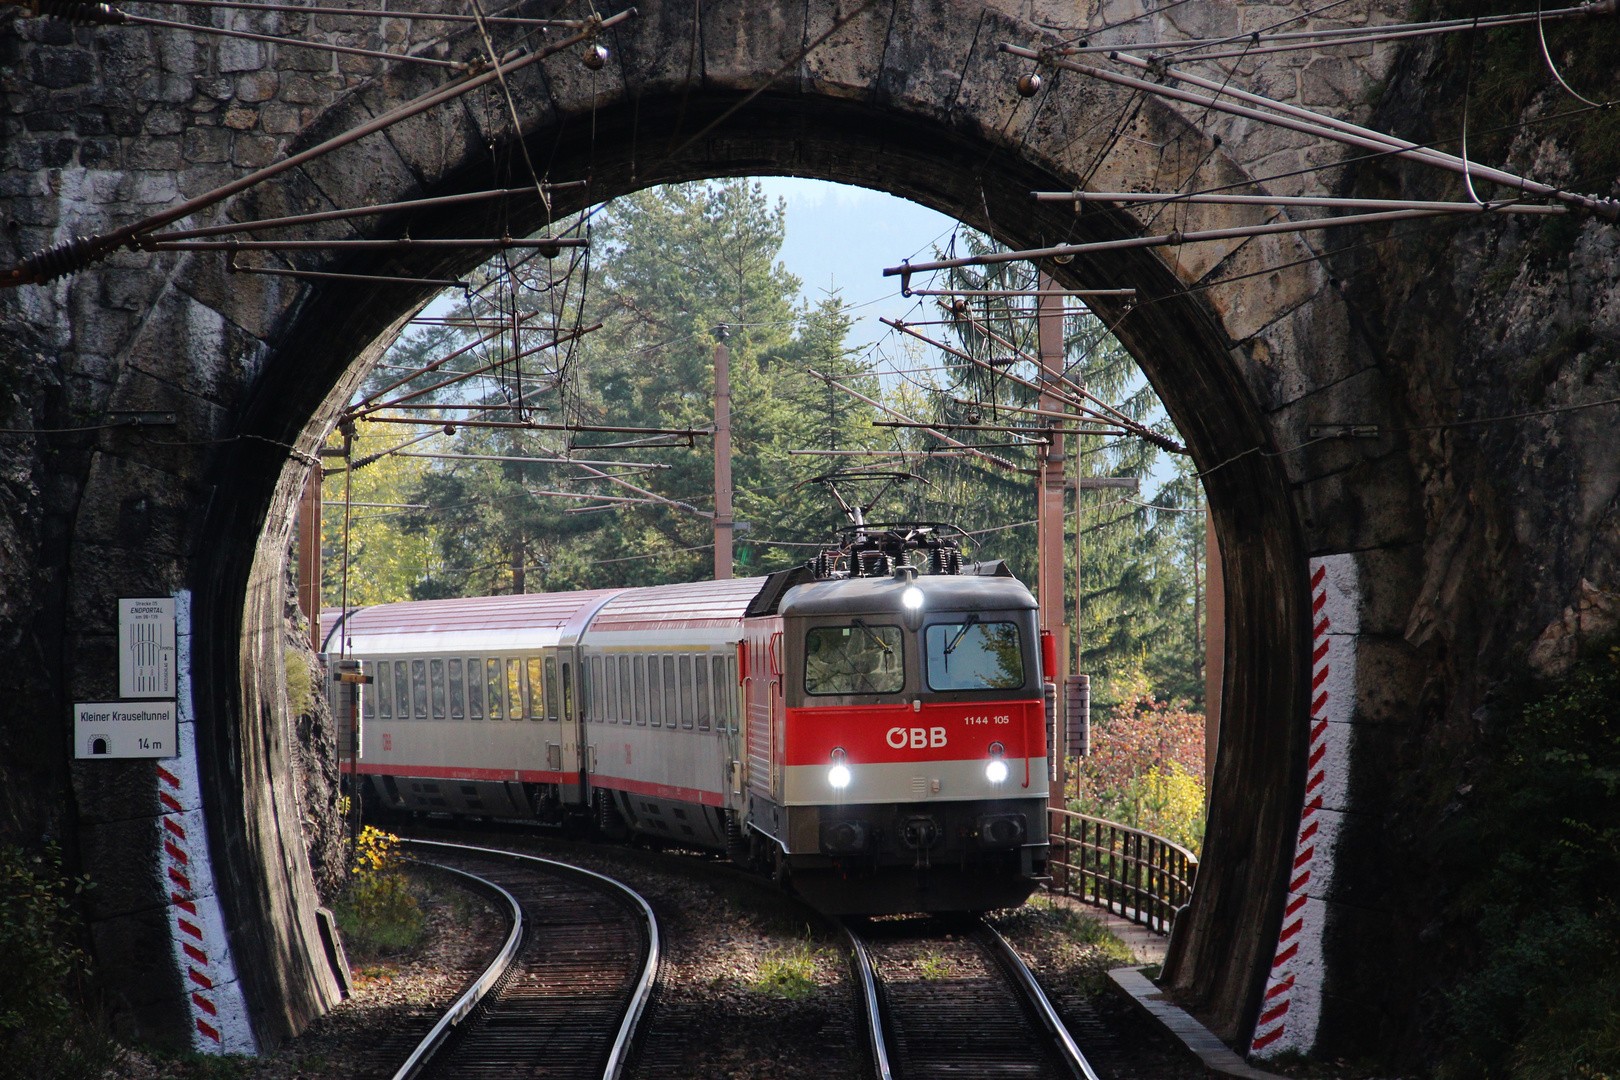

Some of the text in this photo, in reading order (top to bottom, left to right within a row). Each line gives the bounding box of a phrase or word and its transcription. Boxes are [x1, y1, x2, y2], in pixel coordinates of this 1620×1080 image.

[81, 711, 170, 722] Kleiner Krauseltunnel
[964, 715, 1010, 725] 1144 105
[886, 726, 948, 749] ÖBB
[138, 738, 162, 750] 14 m
